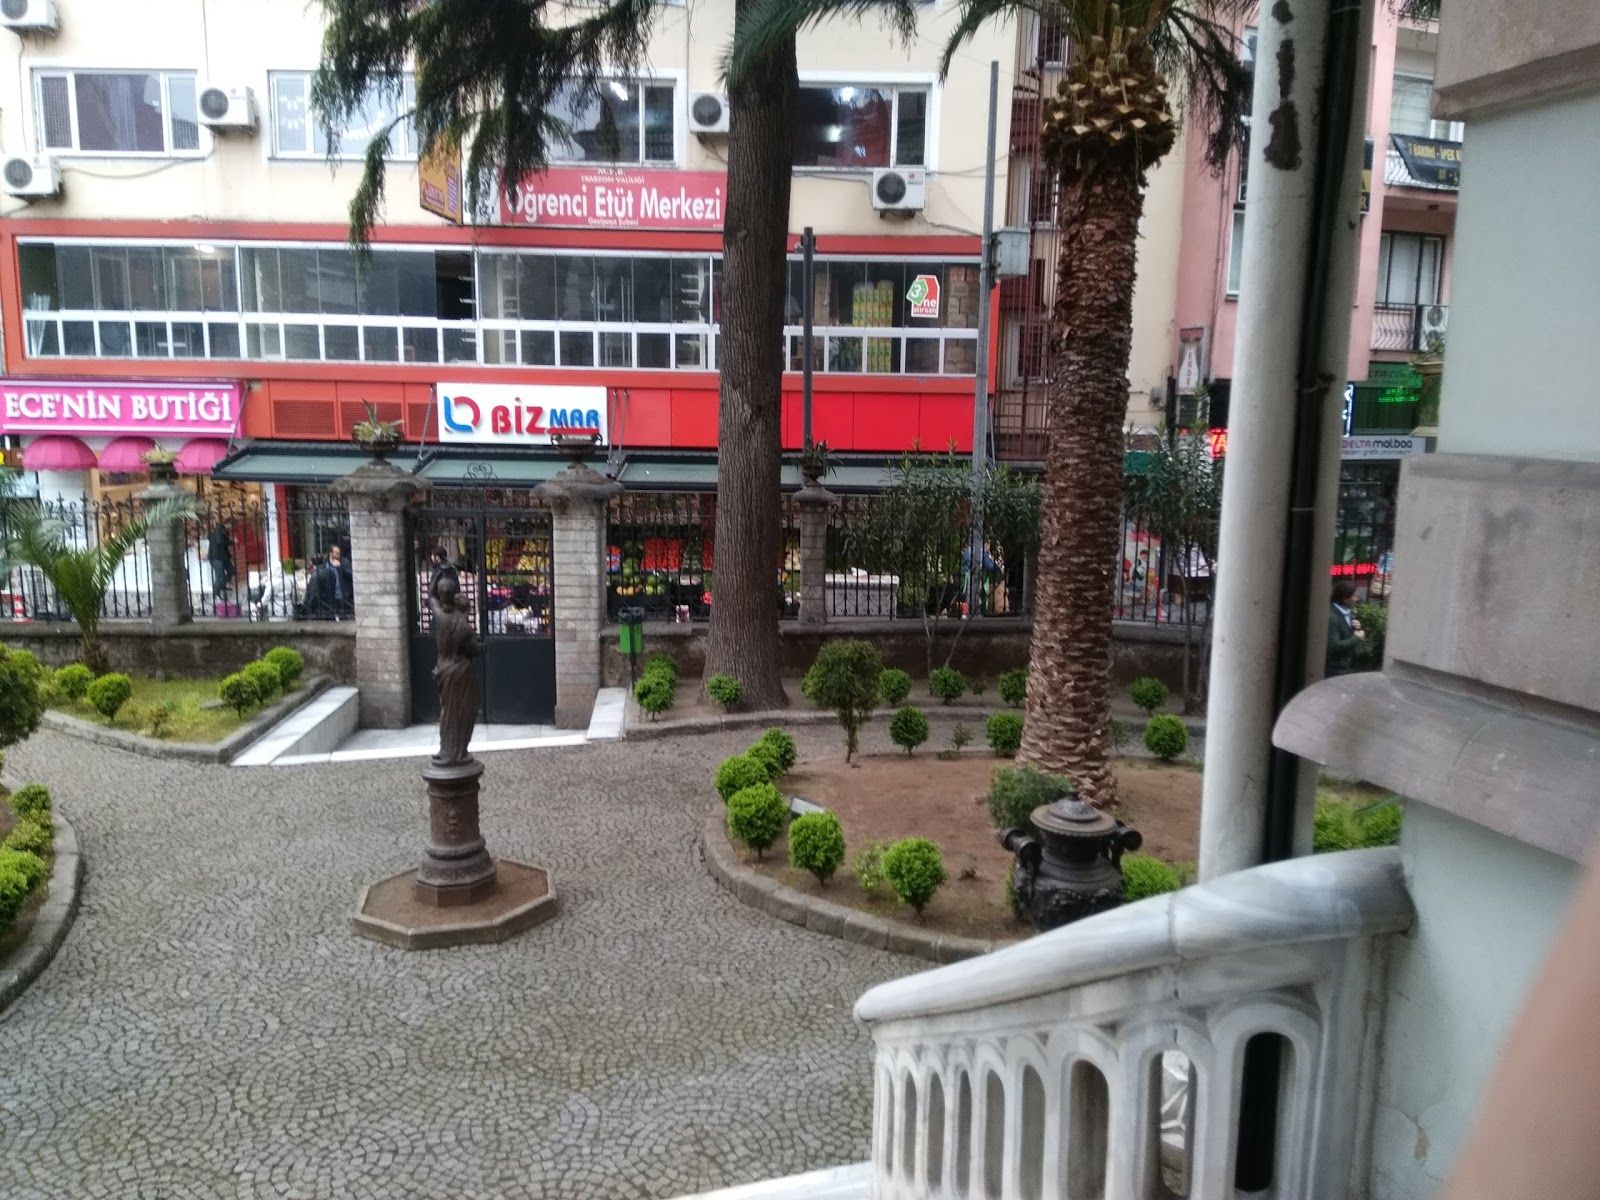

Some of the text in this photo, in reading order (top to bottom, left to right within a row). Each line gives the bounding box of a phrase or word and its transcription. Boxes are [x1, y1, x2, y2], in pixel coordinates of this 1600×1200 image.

[580, 175, 614, 183] TRABZON
[594, 186, 634, 217] Etüt
[639, 186, 721, 220] Merkezi
[3, 390, 232, 421] ECE'NİN BUTİĞİ
